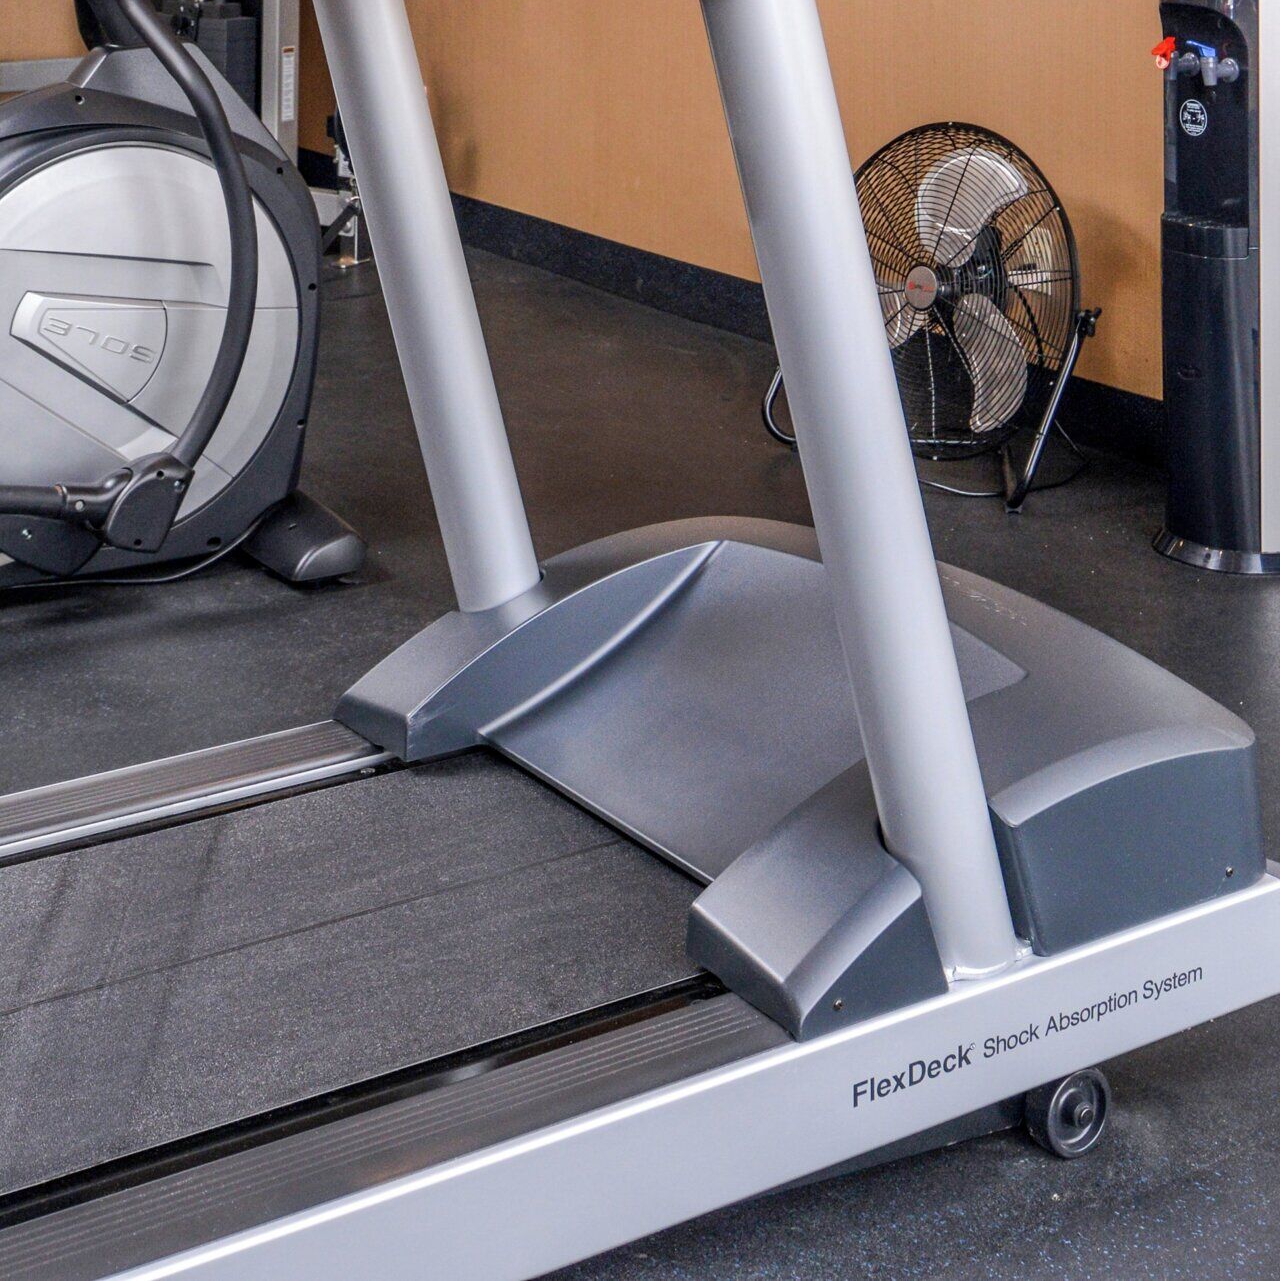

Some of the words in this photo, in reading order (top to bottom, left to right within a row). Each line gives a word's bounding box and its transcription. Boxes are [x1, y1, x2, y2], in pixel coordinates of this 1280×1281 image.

[43, 316, 157, 365] SOLE
[983, 1023, 1040, 1058] Shock
[1044, 989, 1138, 1037] Absorption
[1142, 966, 1203, 1001] System
